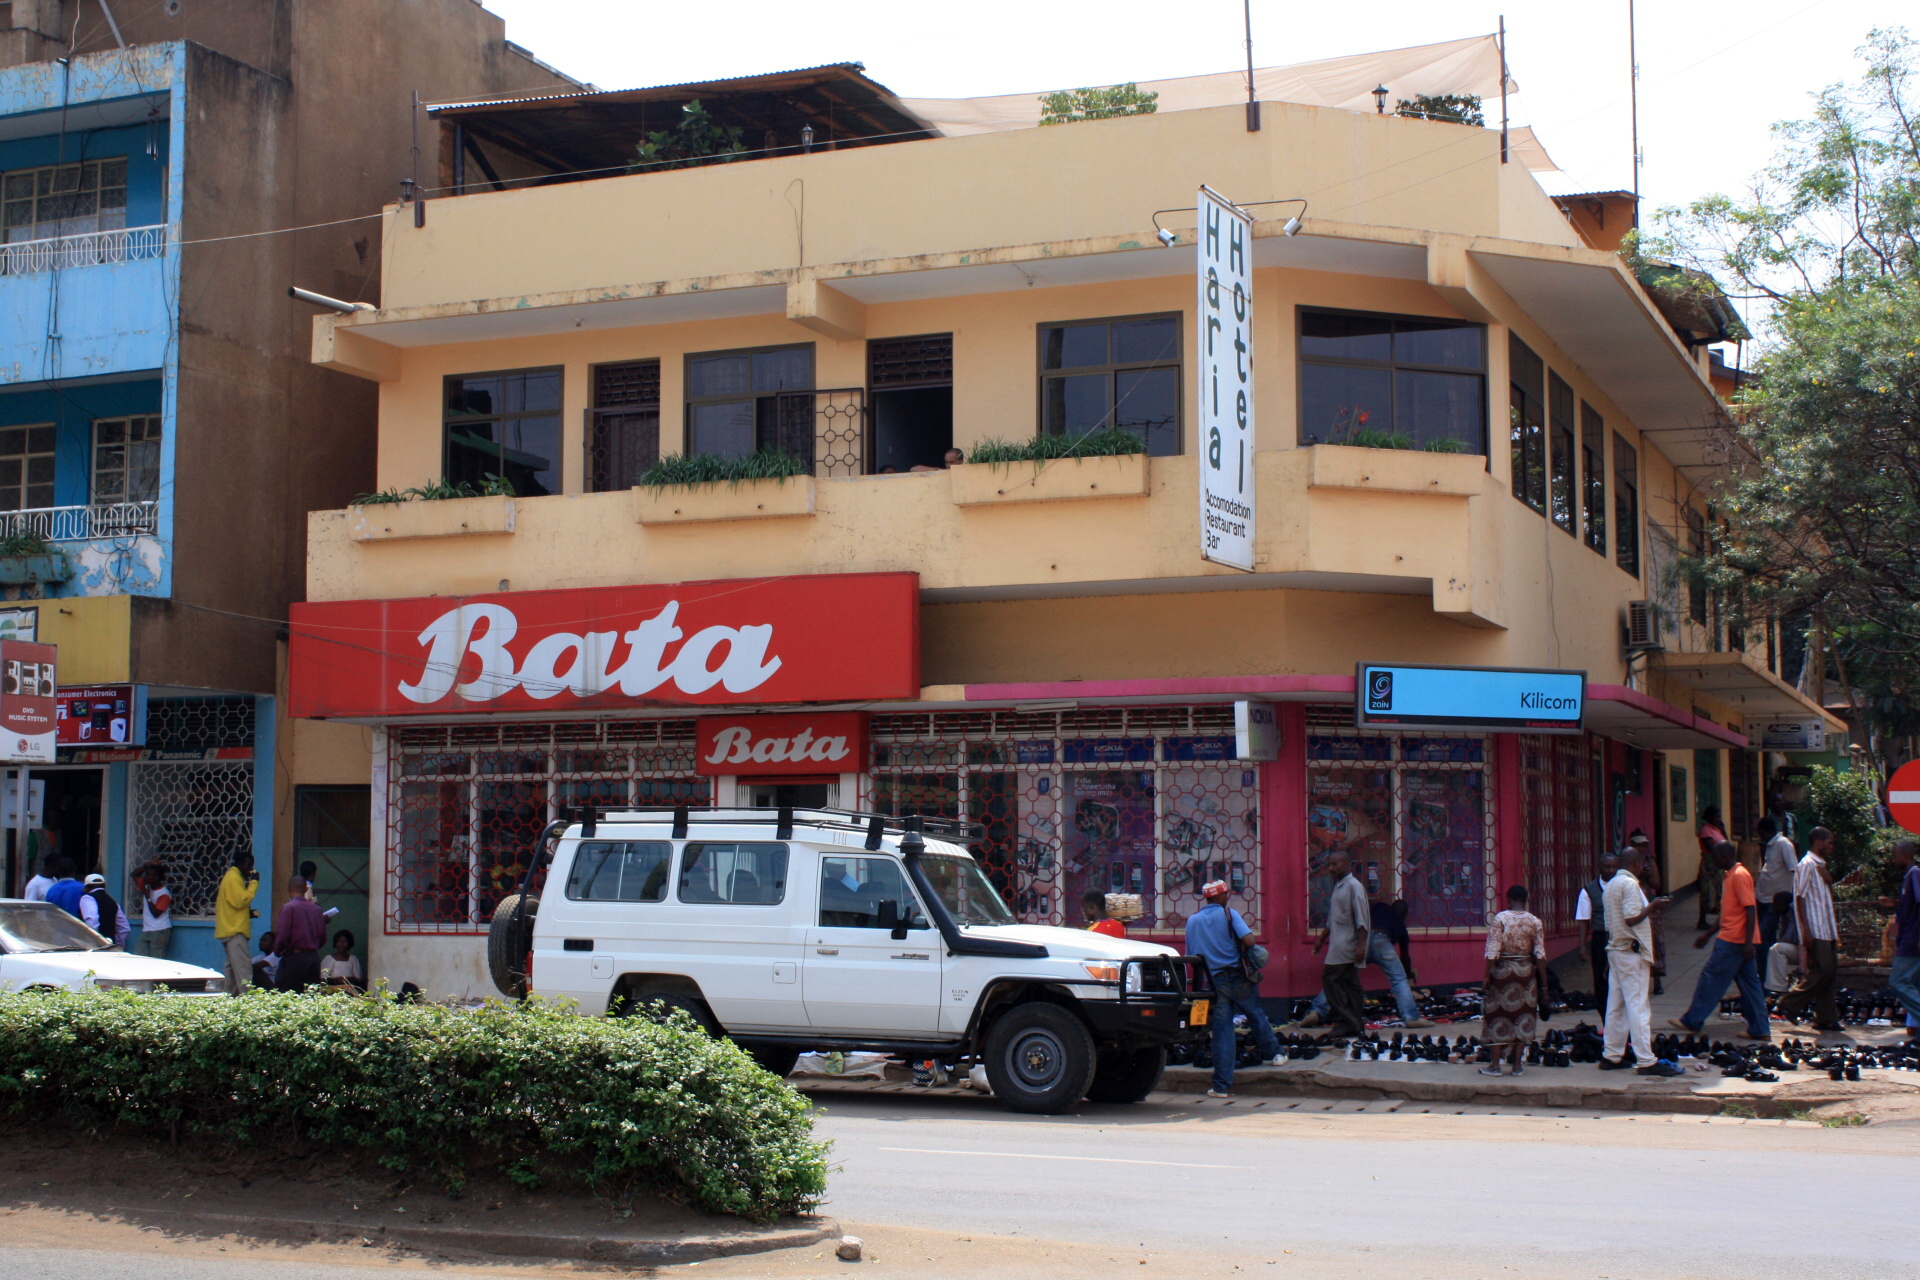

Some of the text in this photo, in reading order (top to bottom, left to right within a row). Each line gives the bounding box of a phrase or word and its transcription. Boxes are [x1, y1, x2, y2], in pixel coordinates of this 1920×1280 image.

[1206, 201, 1221, 471] Haria
[1230, 217, 1247, 494] Hotel
[1206, 488, 1251, 520] Accomodation
[1206, 509, 1246, 538] Restaurant
[1206, 530, 1220, 550] Bar
[398, 600, 782, 703] Bata
[84, 690, 117, 698] Electronics
[1520, 692, 1577, 710] Kilicom
[27, 715, 48, 723] SYSTEM
[1250, 709, 1274, 725] NOKIA
[30, 743, 40, 751] LG
[100, 749, 202, 761] National Panasonic
[705, 726, 850, 764] Bata
